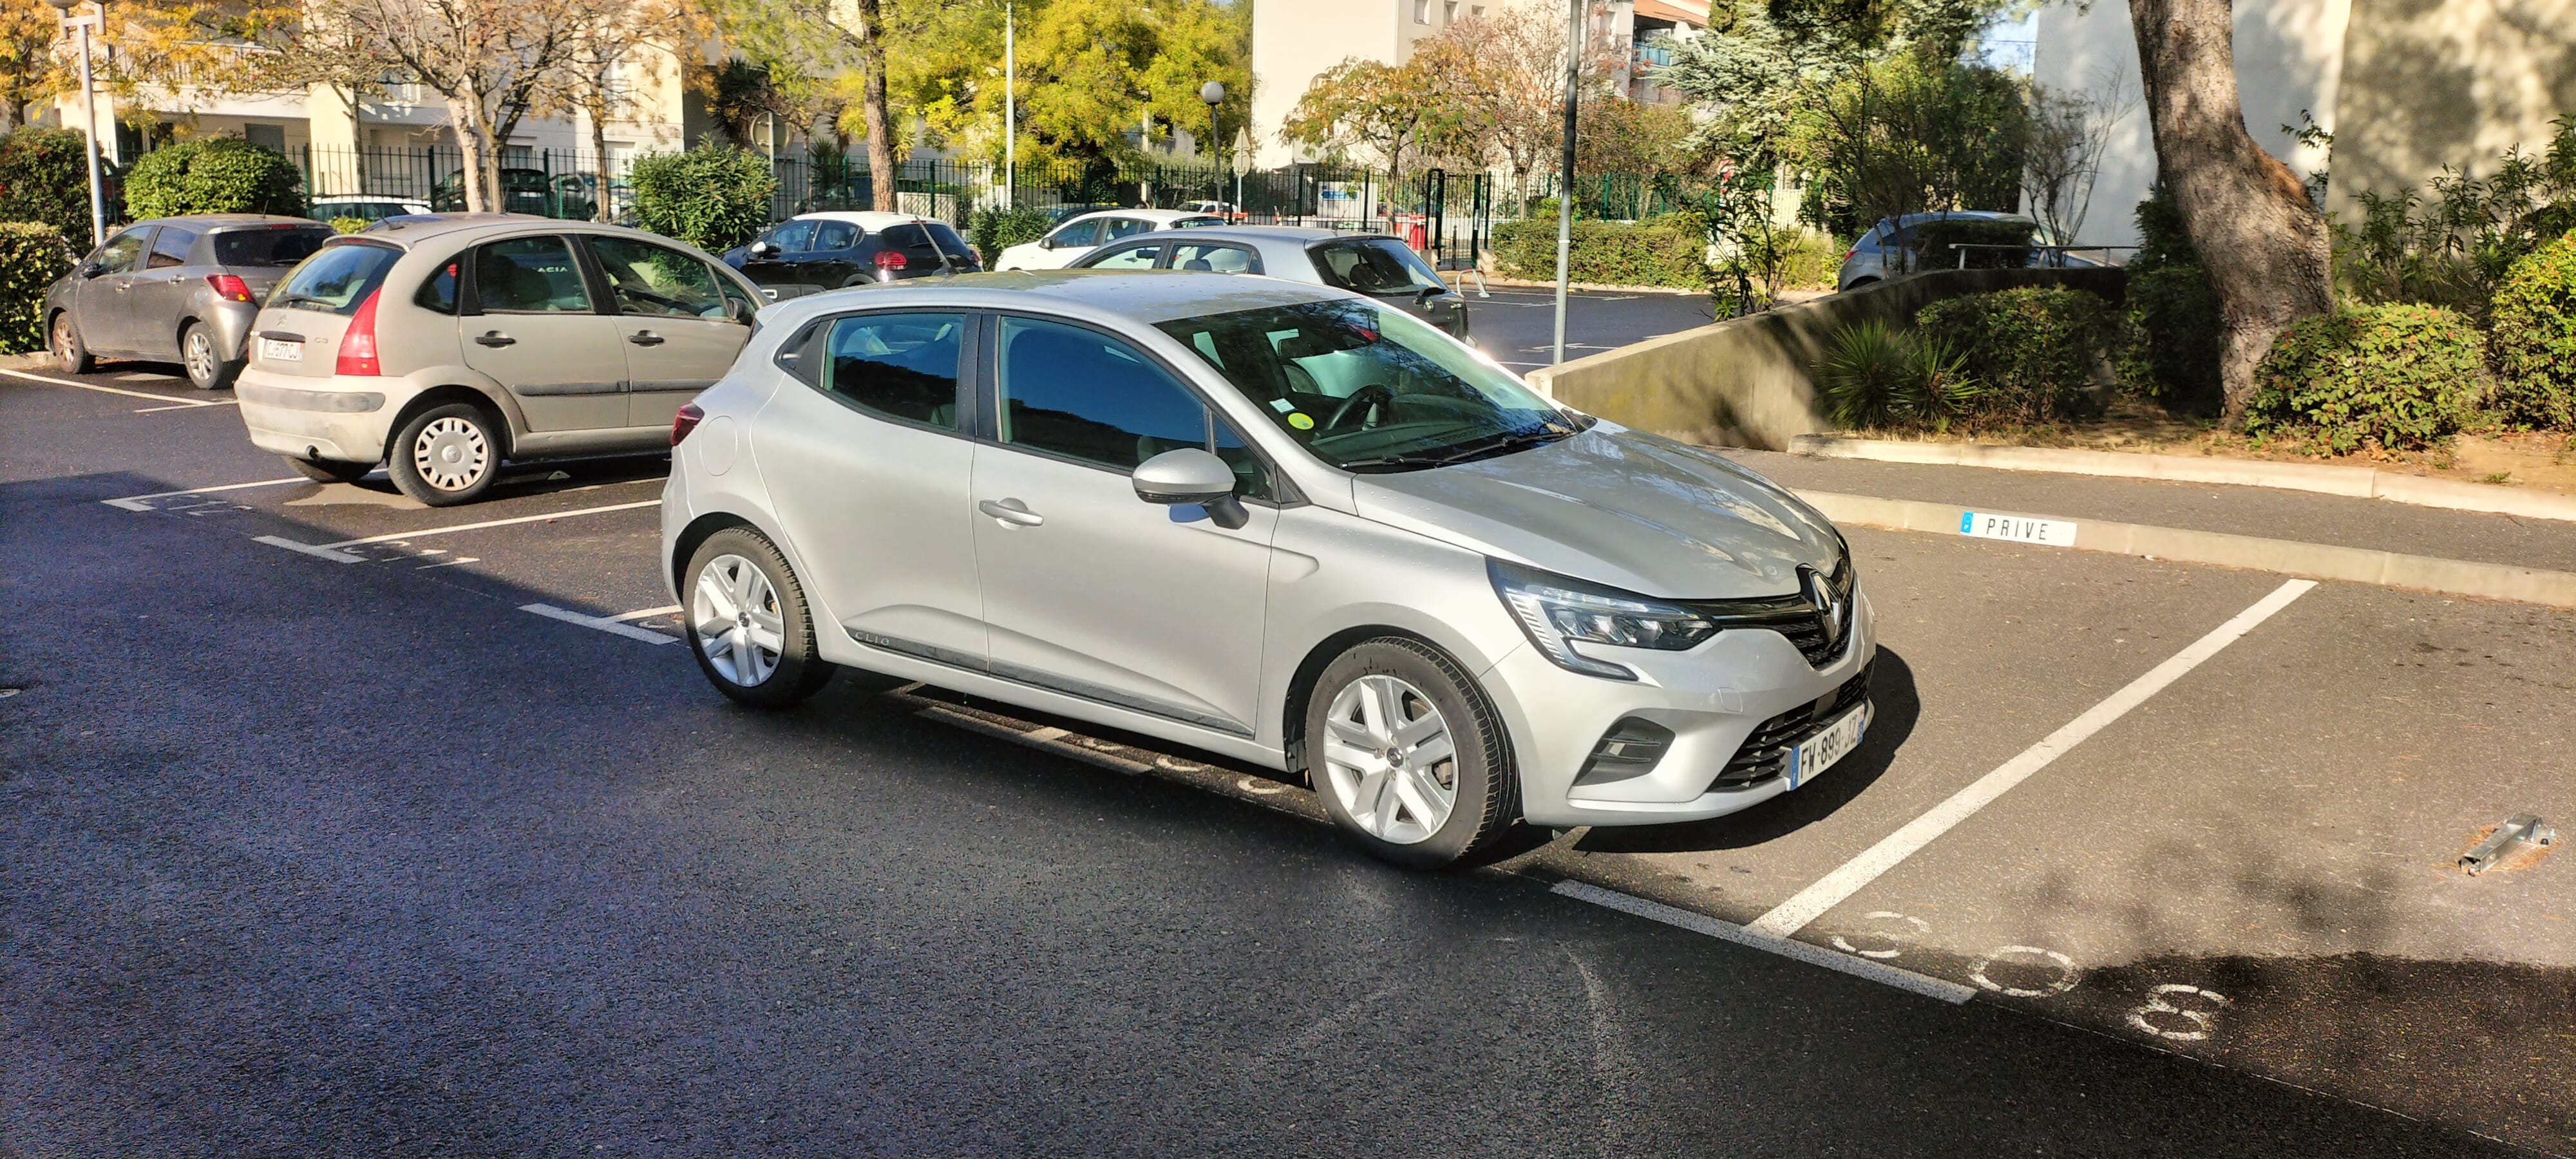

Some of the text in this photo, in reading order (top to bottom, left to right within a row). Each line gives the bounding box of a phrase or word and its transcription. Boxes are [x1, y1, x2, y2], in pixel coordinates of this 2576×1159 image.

[1986, 518, 2049, 540] PRIVE
[855, 632, 889, 646] CLIO
[1832, 910, 2229, 1041] 308
